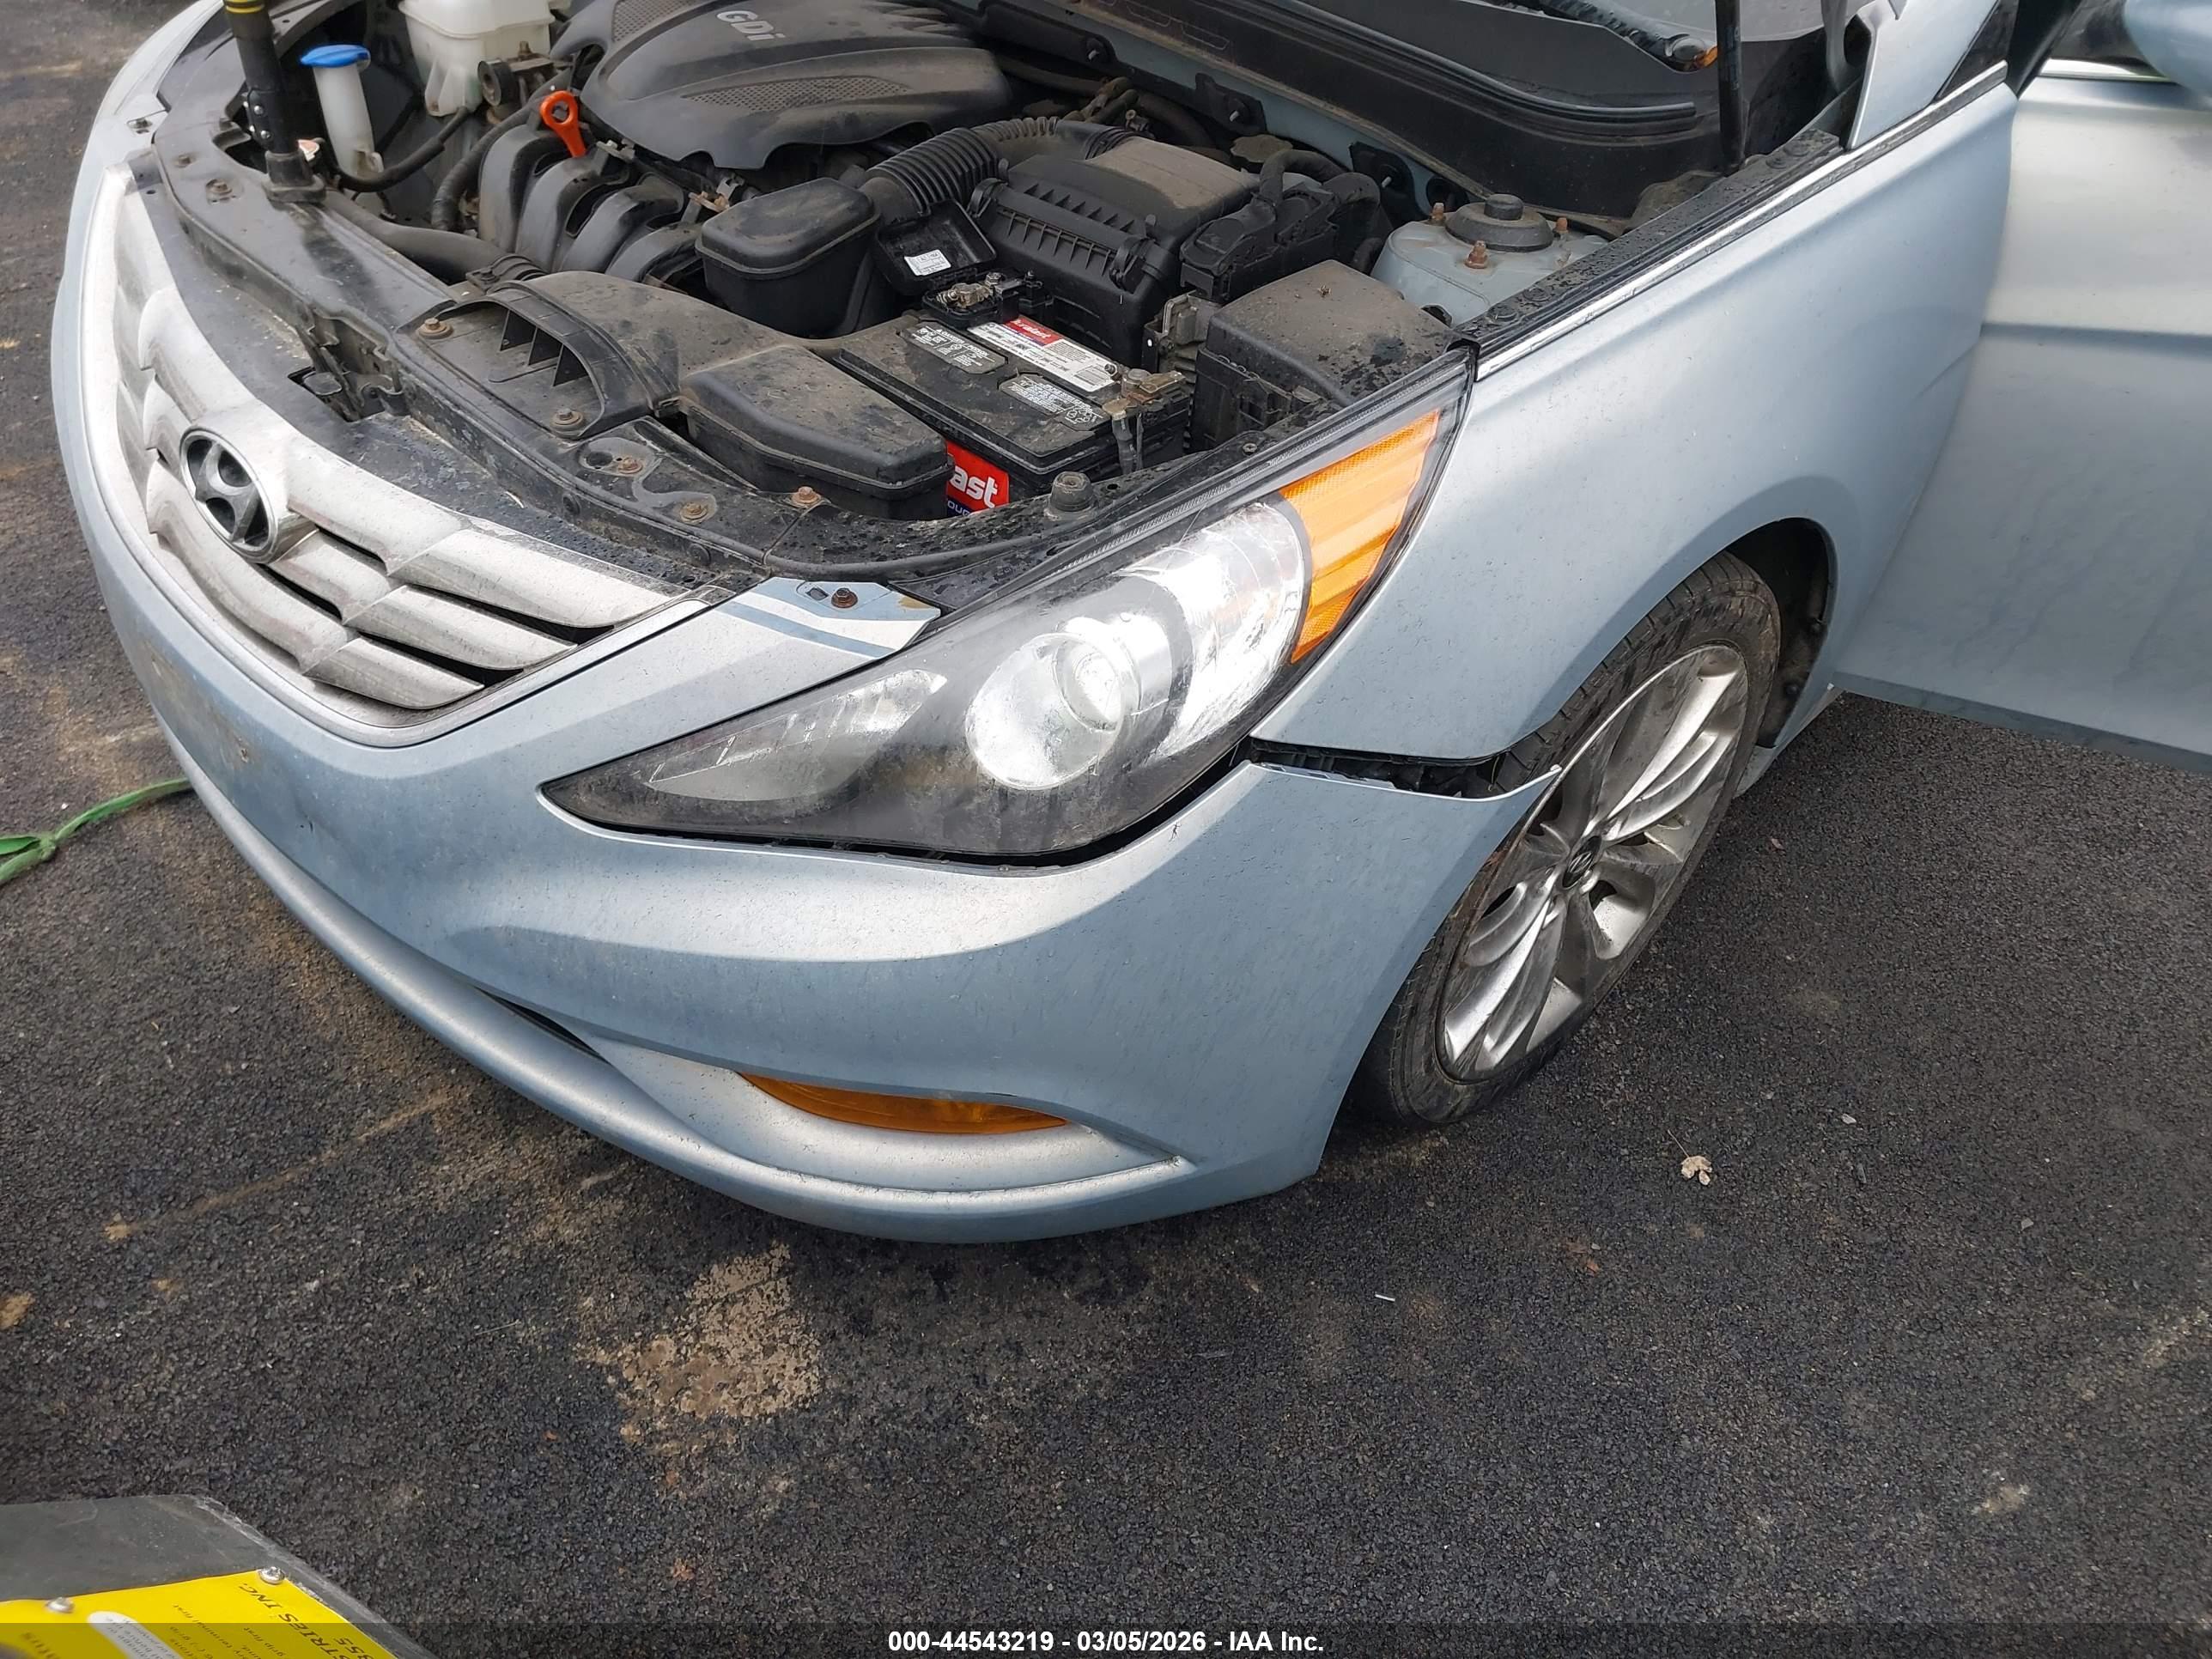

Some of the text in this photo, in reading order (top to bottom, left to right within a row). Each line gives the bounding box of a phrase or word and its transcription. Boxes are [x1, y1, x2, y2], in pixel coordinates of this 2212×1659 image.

[716, 9, 786, 41] GDi
[948, 465, 998, 509] ast
[239, 1583, 283, 1609] INC.
